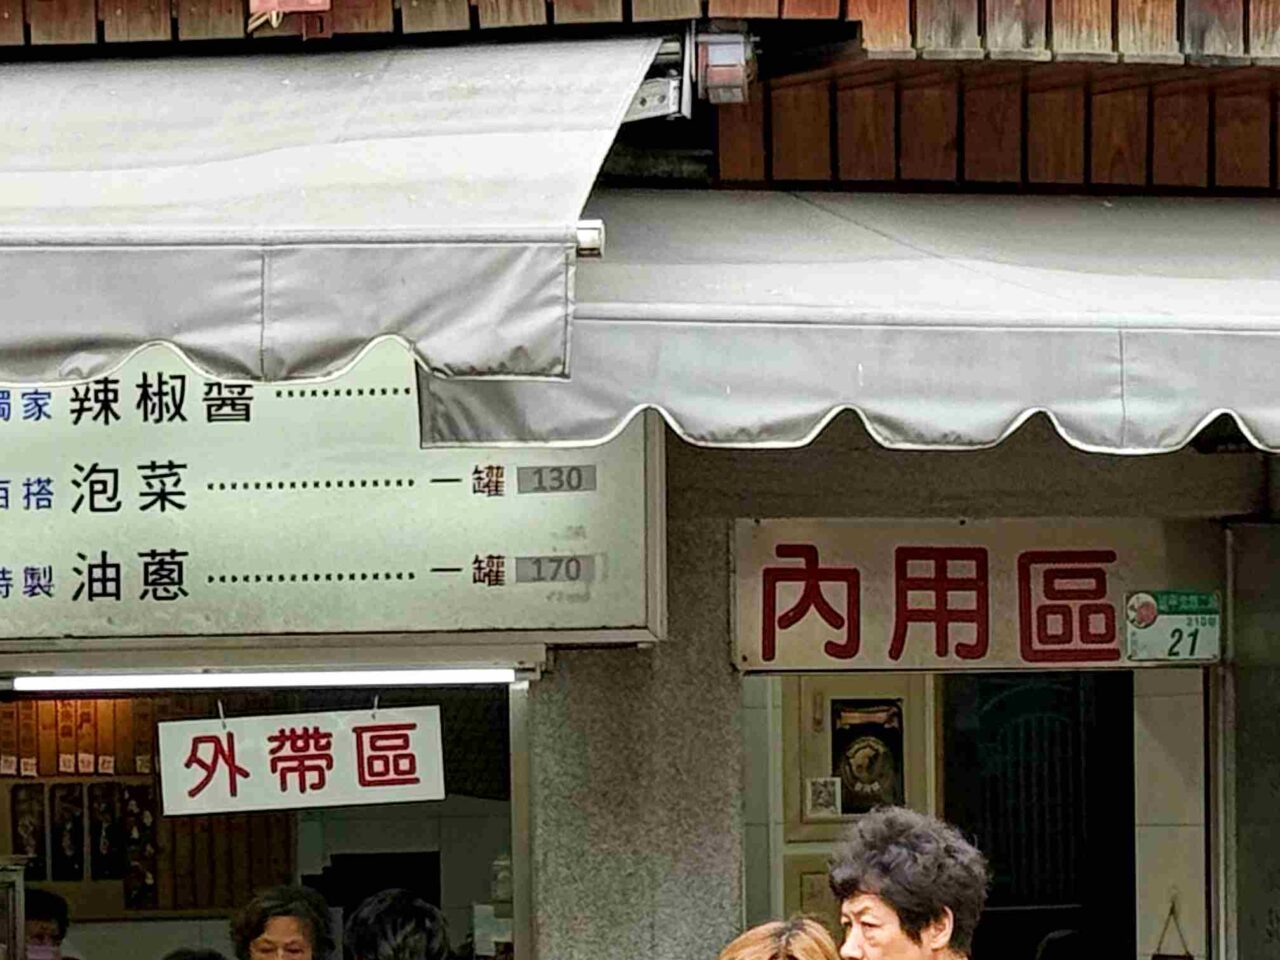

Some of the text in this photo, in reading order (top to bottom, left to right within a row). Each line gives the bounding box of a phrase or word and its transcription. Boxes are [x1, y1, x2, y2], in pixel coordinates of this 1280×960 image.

[70, 371, 254, 426] 辣椒醬
[71, 460, 188, 513] 泡菜
[429, 464, 506, 497] 一罐
[532, 466, 583, 491] 130
[71, 548, 190, 602] 油蔥
[429, 554, 507, 587] 一罐
[531, 557, 582, 582] 170
[761, 543, 1121, 662] 內用區
[1168, 628, 1199, 656] 21
[184, 722, 421, 798] 外帶區
